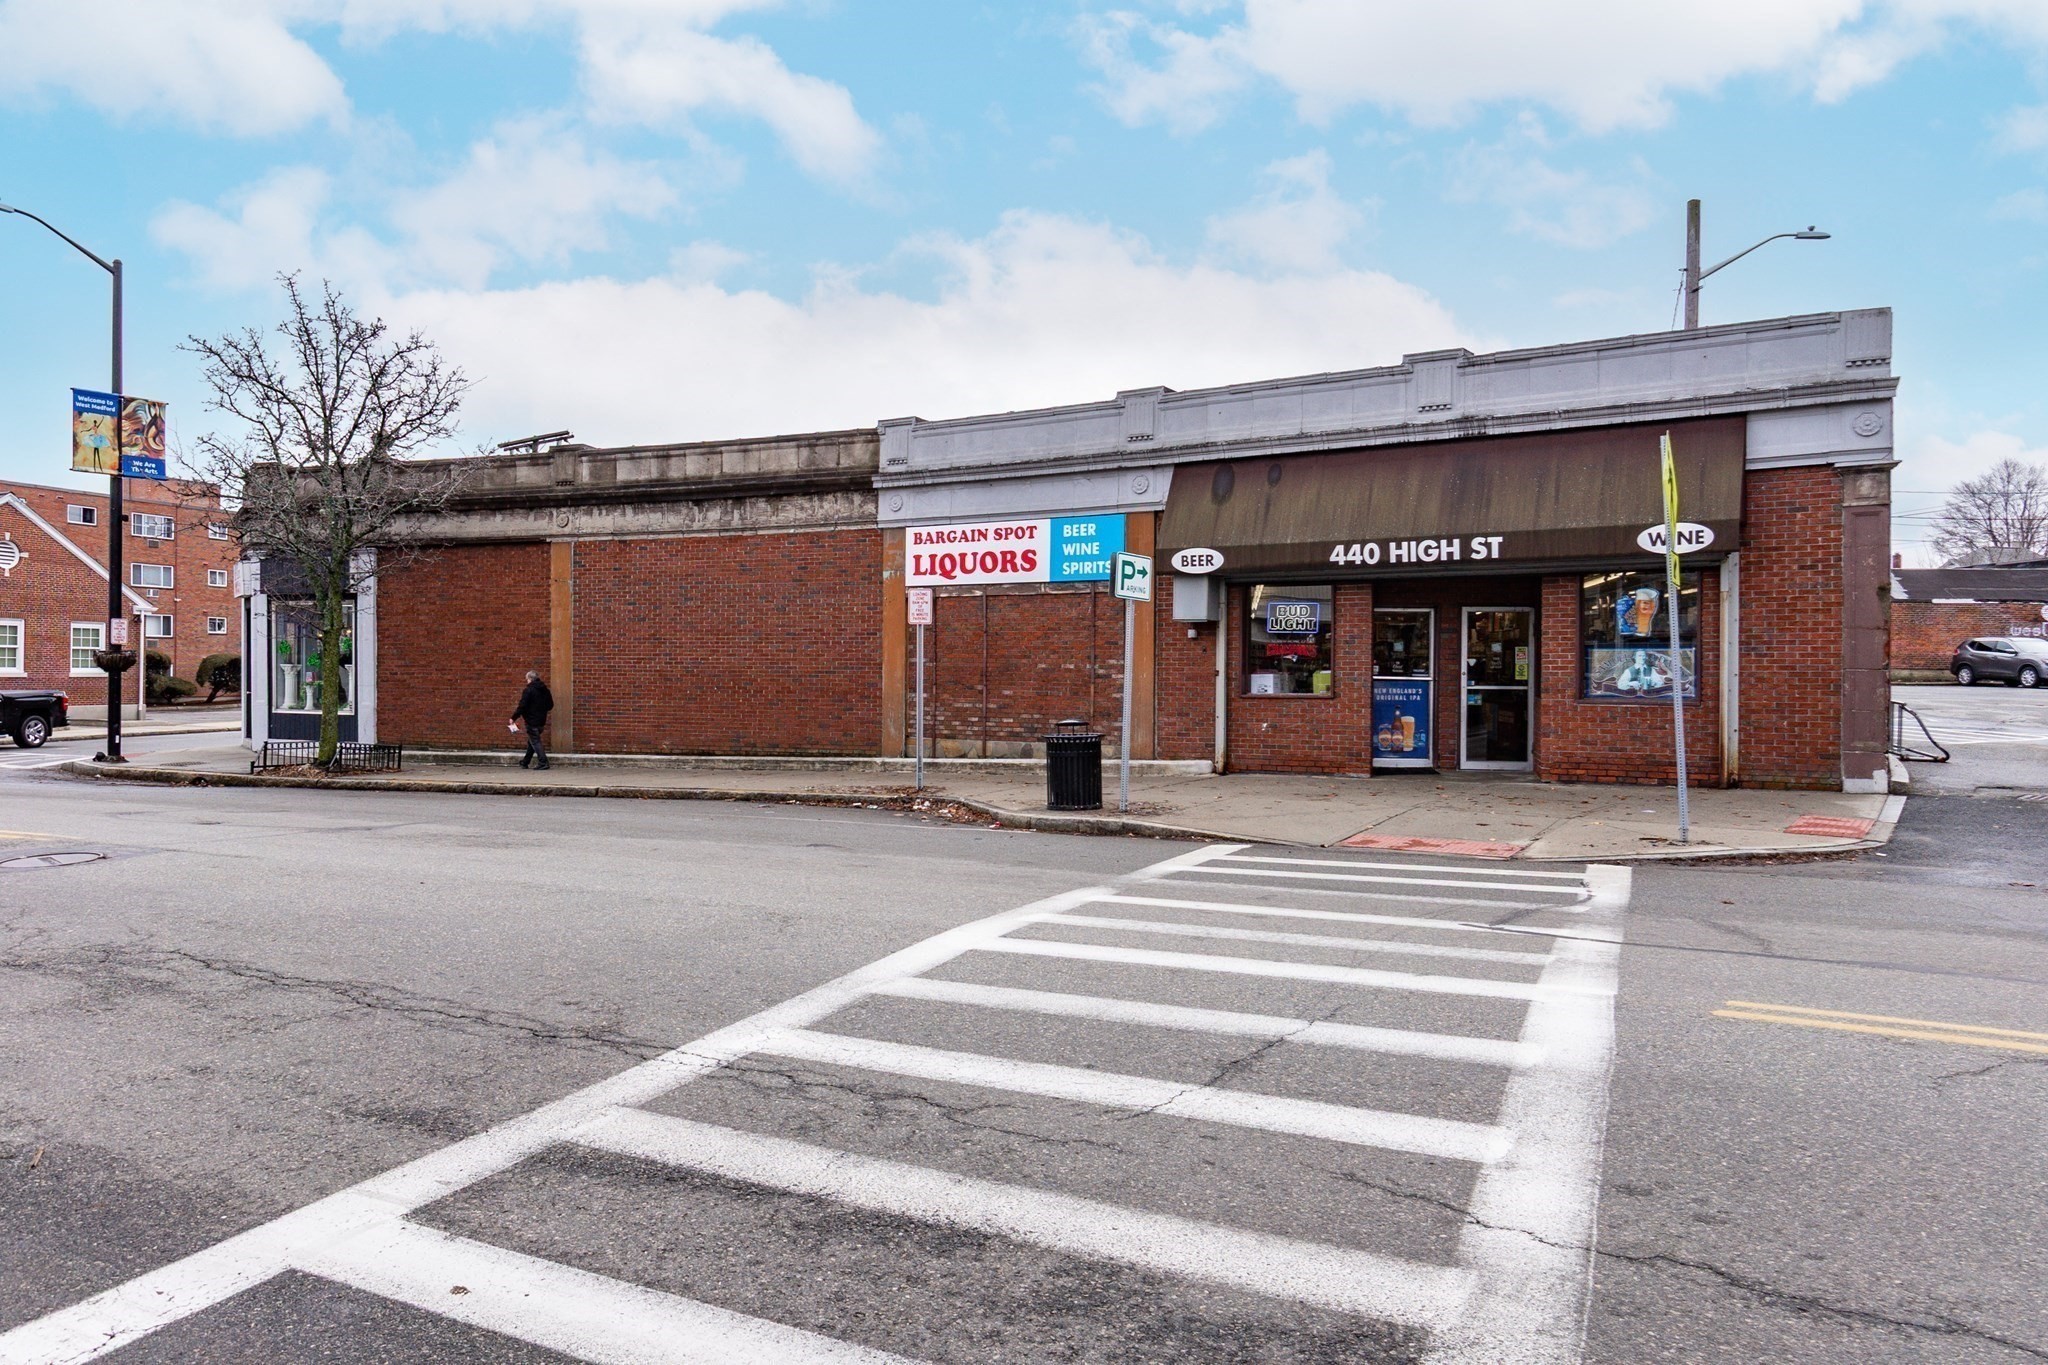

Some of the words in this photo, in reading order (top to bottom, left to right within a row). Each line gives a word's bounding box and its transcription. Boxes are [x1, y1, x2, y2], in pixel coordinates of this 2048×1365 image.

[75, 401, 90, 409] West
[91, 404, 116, 412] Medford
[77, 395, 106, 405] Welcome
[144, 467, 159, 475] Arts
[913, 528, 989, 545] BARGAIN
[993, 525, 1037, 541] SPOT
[1063, 523, 1096, 537] BEER
[1647, 529, 1705, 547] WNE
[1062, 541, 1100, 556] WINE
[1329, 542, 1381, 566] 440
[1389, 538, 1460, 564] HIGH
[1470, 536, 1503, 560] ST
[912, 549, 1037, 580] LIQUORS
[1062, 561, 1111, 575] SPIRITS
[1181, 554, 1214, 568] BEER
[1276, 604, 1310, 618] BUD
[1269, 617, 1316, 630] LIGHT
